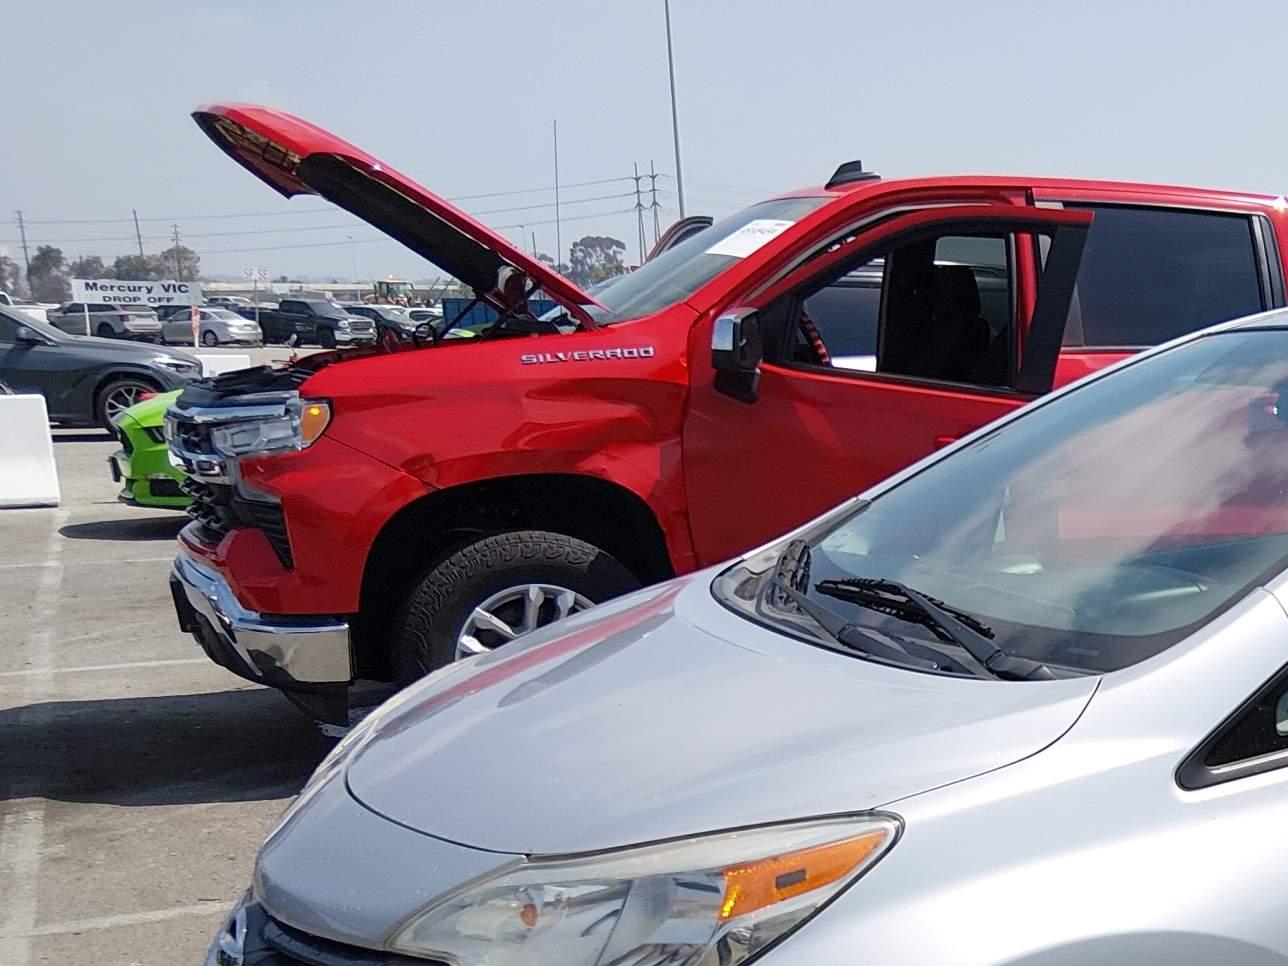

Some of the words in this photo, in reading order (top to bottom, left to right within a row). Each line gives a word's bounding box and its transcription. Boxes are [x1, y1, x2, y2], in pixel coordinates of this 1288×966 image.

[84, 282, 153, 294] Mercury
[161, 283, 190, 294] VIC
[102, 295, 141, 303] DROP
[147, 296, 175, 304] OFF
[520, 346, 655, 365] SILVERADO
